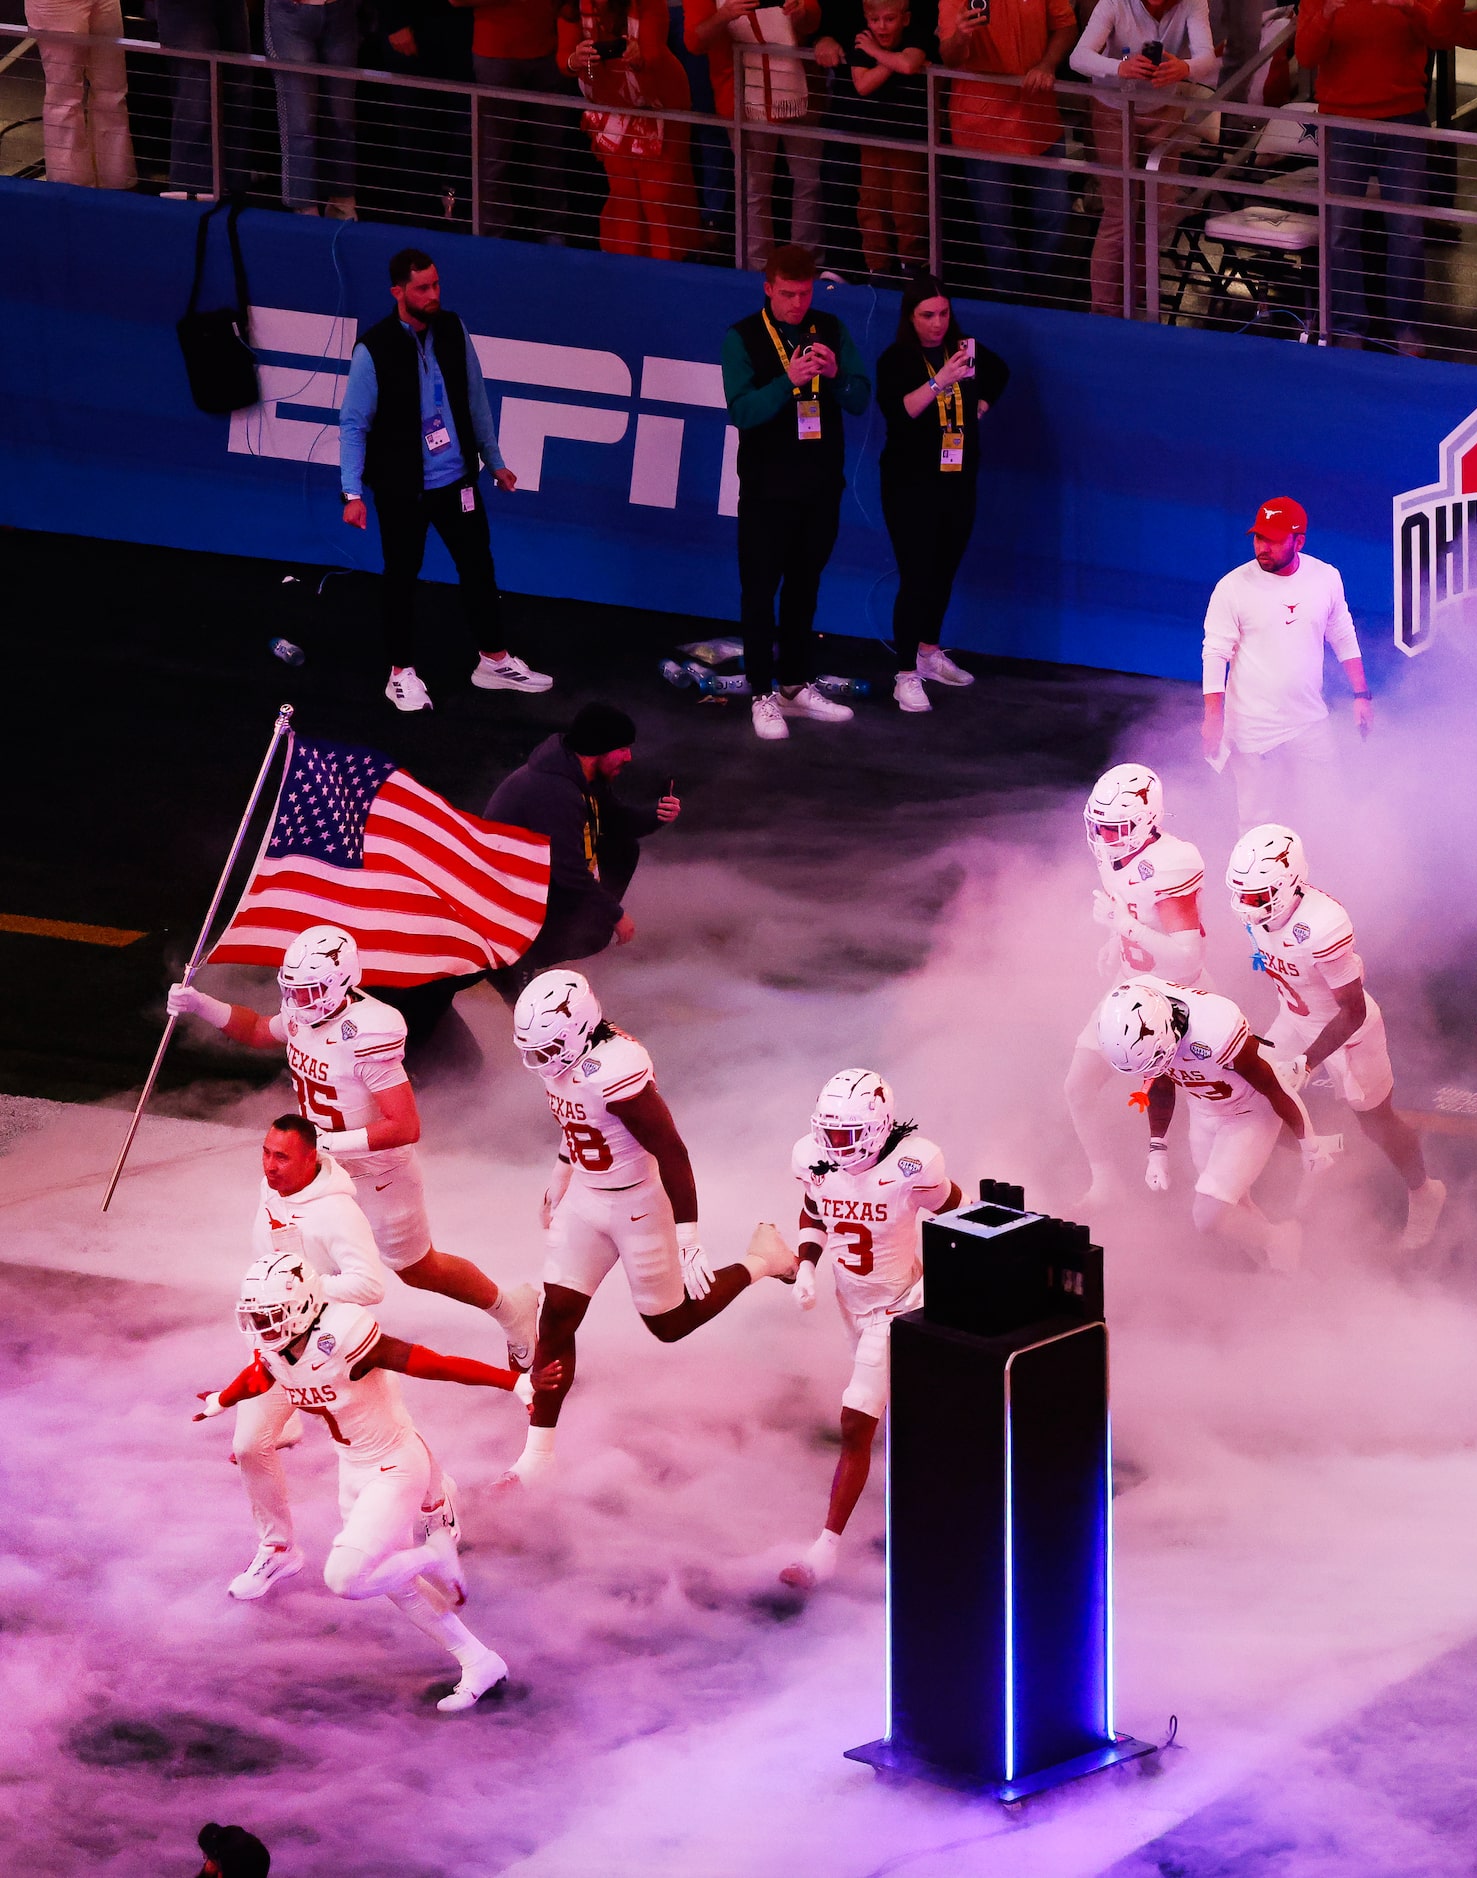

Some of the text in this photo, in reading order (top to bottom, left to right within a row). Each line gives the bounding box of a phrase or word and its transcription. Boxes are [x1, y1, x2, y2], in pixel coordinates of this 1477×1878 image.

[821, 1198, 888, 1222] TEXAS
[833, 1221, 874, 1277] 3
[297, 1406, 352, 1446] 7
